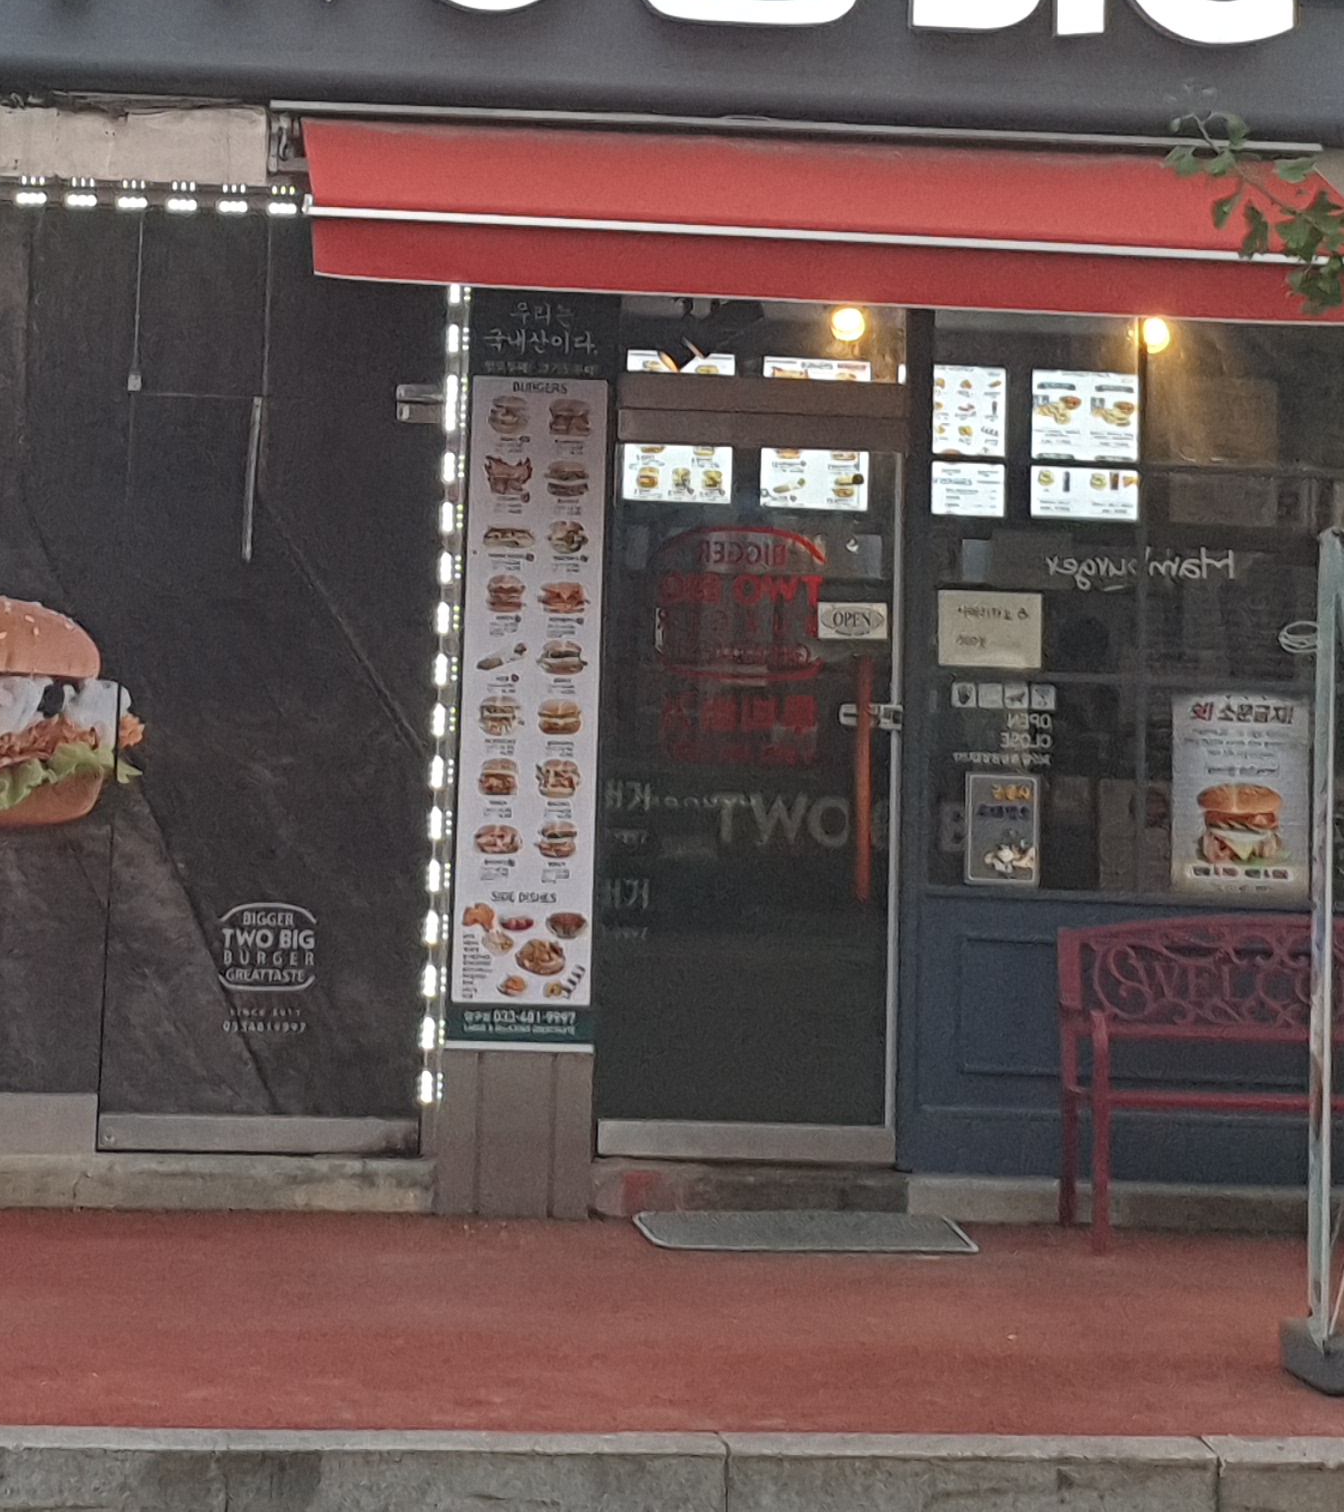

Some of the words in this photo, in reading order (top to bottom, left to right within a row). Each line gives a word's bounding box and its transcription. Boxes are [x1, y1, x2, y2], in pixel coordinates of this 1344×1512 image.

[832, 610, 871, 628] OPEN
[242, 911, 295, 927] BIGGER
[221, 928, 275, 950] TWO
[278, 928, 316, 950] BIG
[223, 950, 315, 967] BURGER
